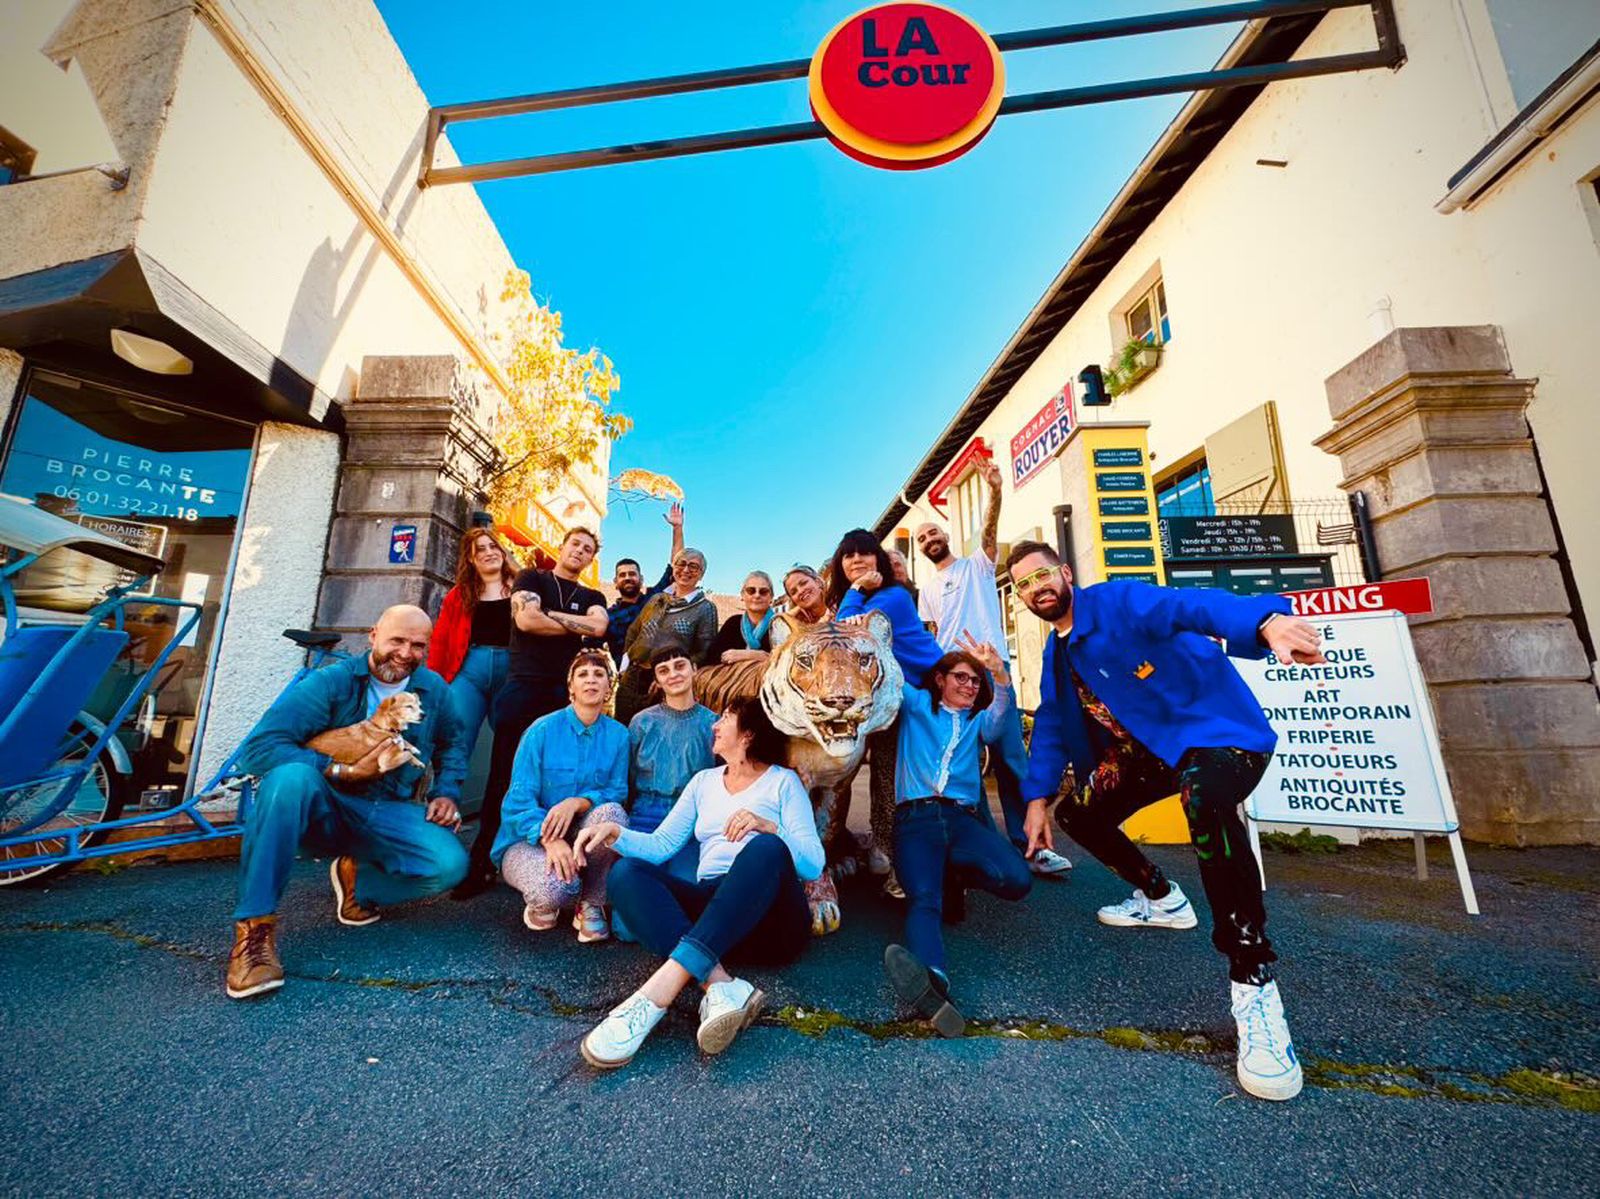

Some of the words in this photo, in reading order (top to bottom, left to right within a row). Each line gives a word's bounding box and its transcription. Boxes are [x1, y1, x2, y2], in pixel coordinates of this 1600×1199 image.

[862, 17, 939, 57] LA
[858, 62, 971, 88] Cour
[1078, 364, 1112, 406] 1
[1013, 408, 1052, 451] COGNAC
[1015, 415, 1070, 479] ROUYER
[83, 448, 193, 482] PIERRE
[46, 460, 217, 505] BROCANTE
[54, 485, 199, 521] 06.01.32.21.18
[88, 521, 151, 537] HORAIRES
[1181, 537, 1211, 545] Vendredi
[1290, 587, 1384, 615] RKING
[1265, 664, 1375, 682] CRÉATEURS
[1304, 690, 1340, 703] ART
[1263, 705, 1411, 720] ONTEMPORAIN
[1287, 730, 1376, 744] FRIPERIE
[1277, 754, 1397, 770] TATOUEURS
[1280, 778, 1406, 796] ANTIQUITÉS
[1288, 796, 1404, 815] BROCANTE
